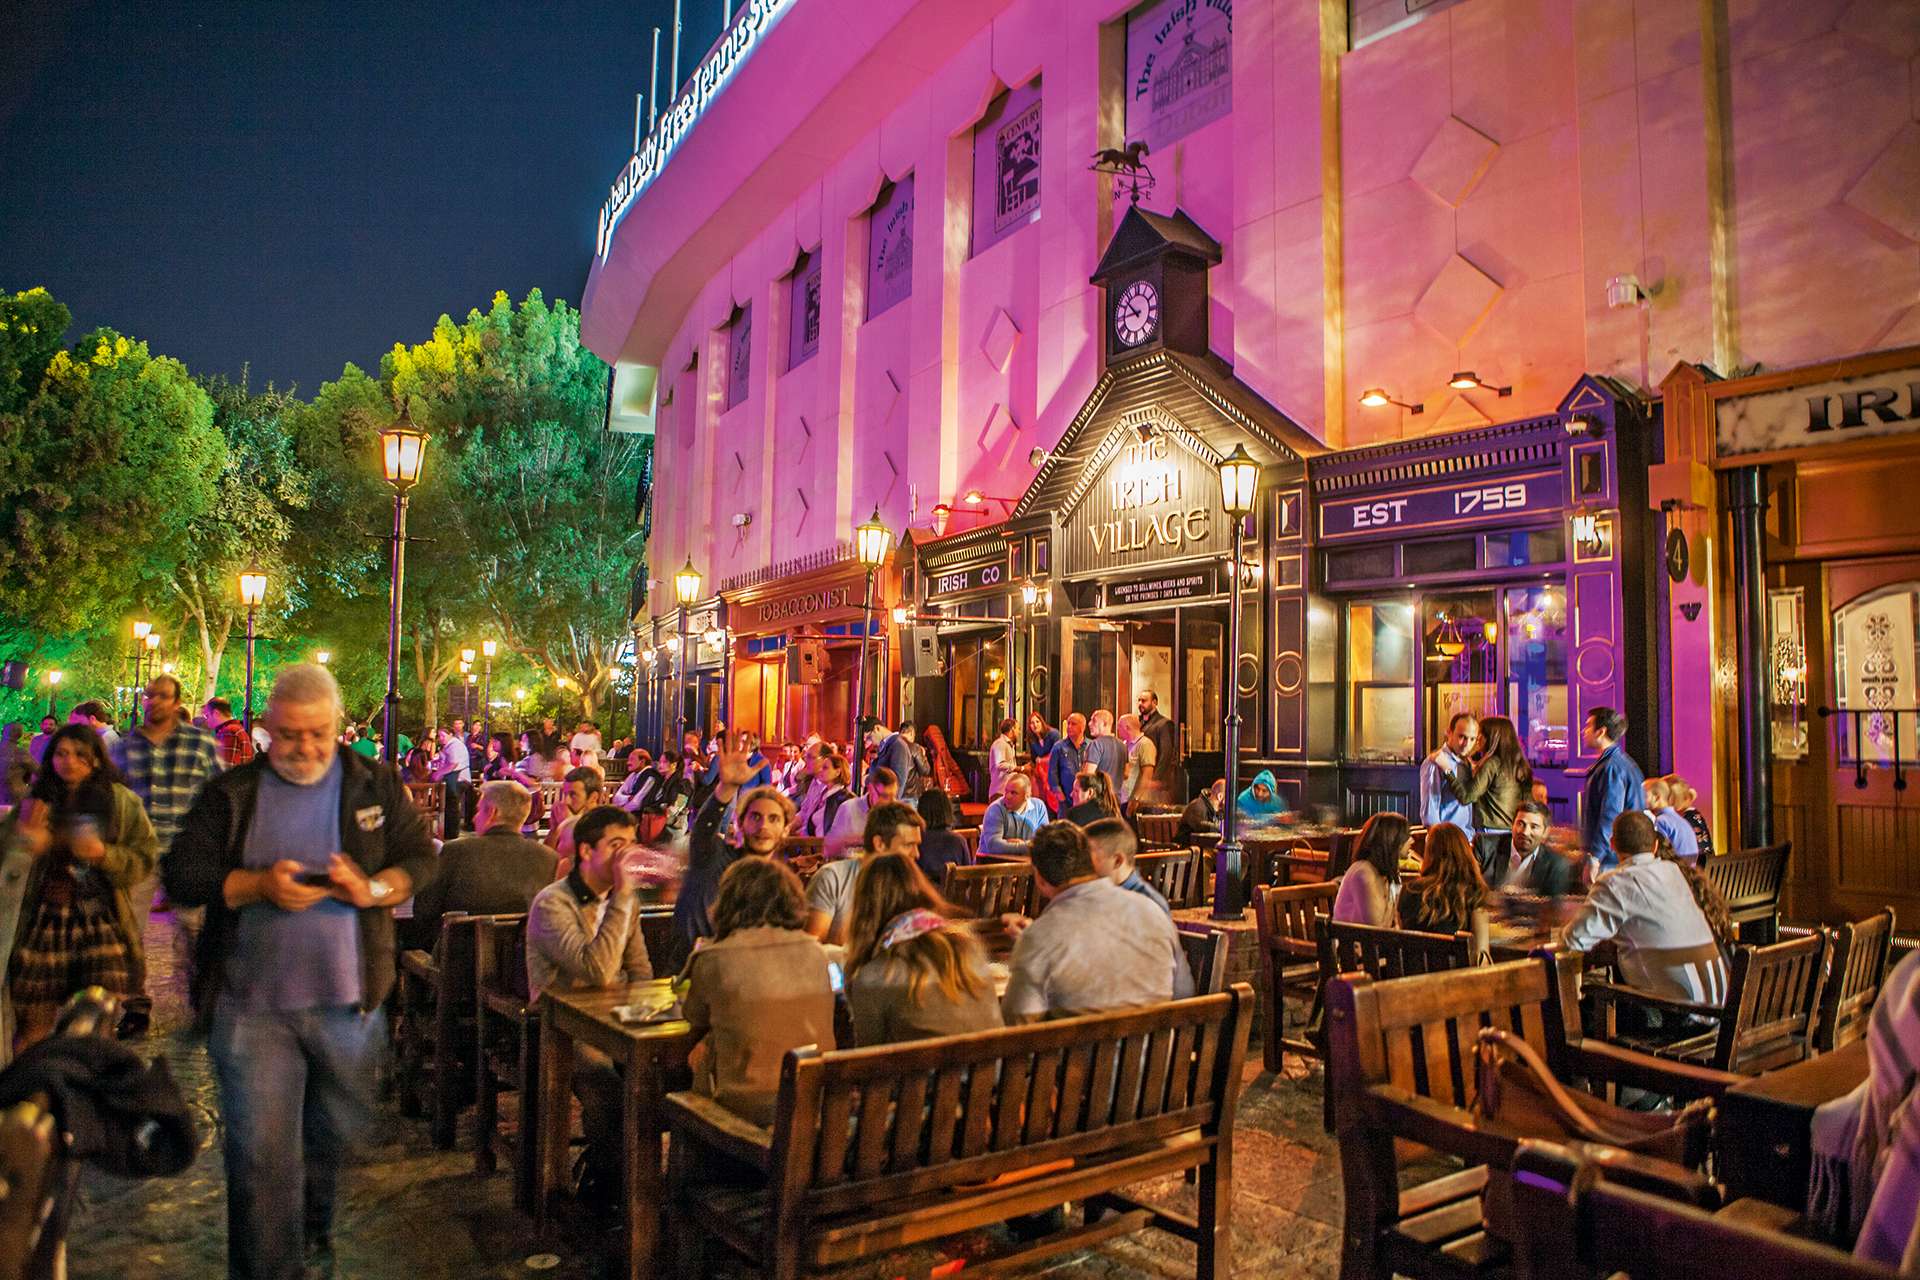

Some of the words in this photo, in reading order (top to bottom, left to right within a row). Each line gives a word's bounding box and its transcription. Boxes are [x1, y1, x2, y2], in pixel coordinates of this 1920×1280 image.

[1135, 53, 1156, 101] The
[629, 135, 658, 188] Duty
[659, 94, 691, 151] Free
[691, 17, 749, 103] Tennis
[1125, 437, 1169, 465] THE
[1353, 499, 1408, 528] EST
[1454, 483, 1527, 515] 1759
[1088, 507, 1209, 556] VILLAGE
[1672, 538, 1683, 572] 4
[938, 572, 969, 595] IRISH
[981, 565, 1001, 585] CO
[1125, 594, 1131, 603] ON
[1131, 592, 1139, 601] THE
[1133, 584, 1139, 593] TO
[1139, 583, 1149, 592] SELL
[1162, 578, 1176, 588] BEERS
[1176, 577, 1186, 588] AND
[1186, 575, 1203, 586] SPIRITS
[758, 586, 851, 623] TOBACCONIST
